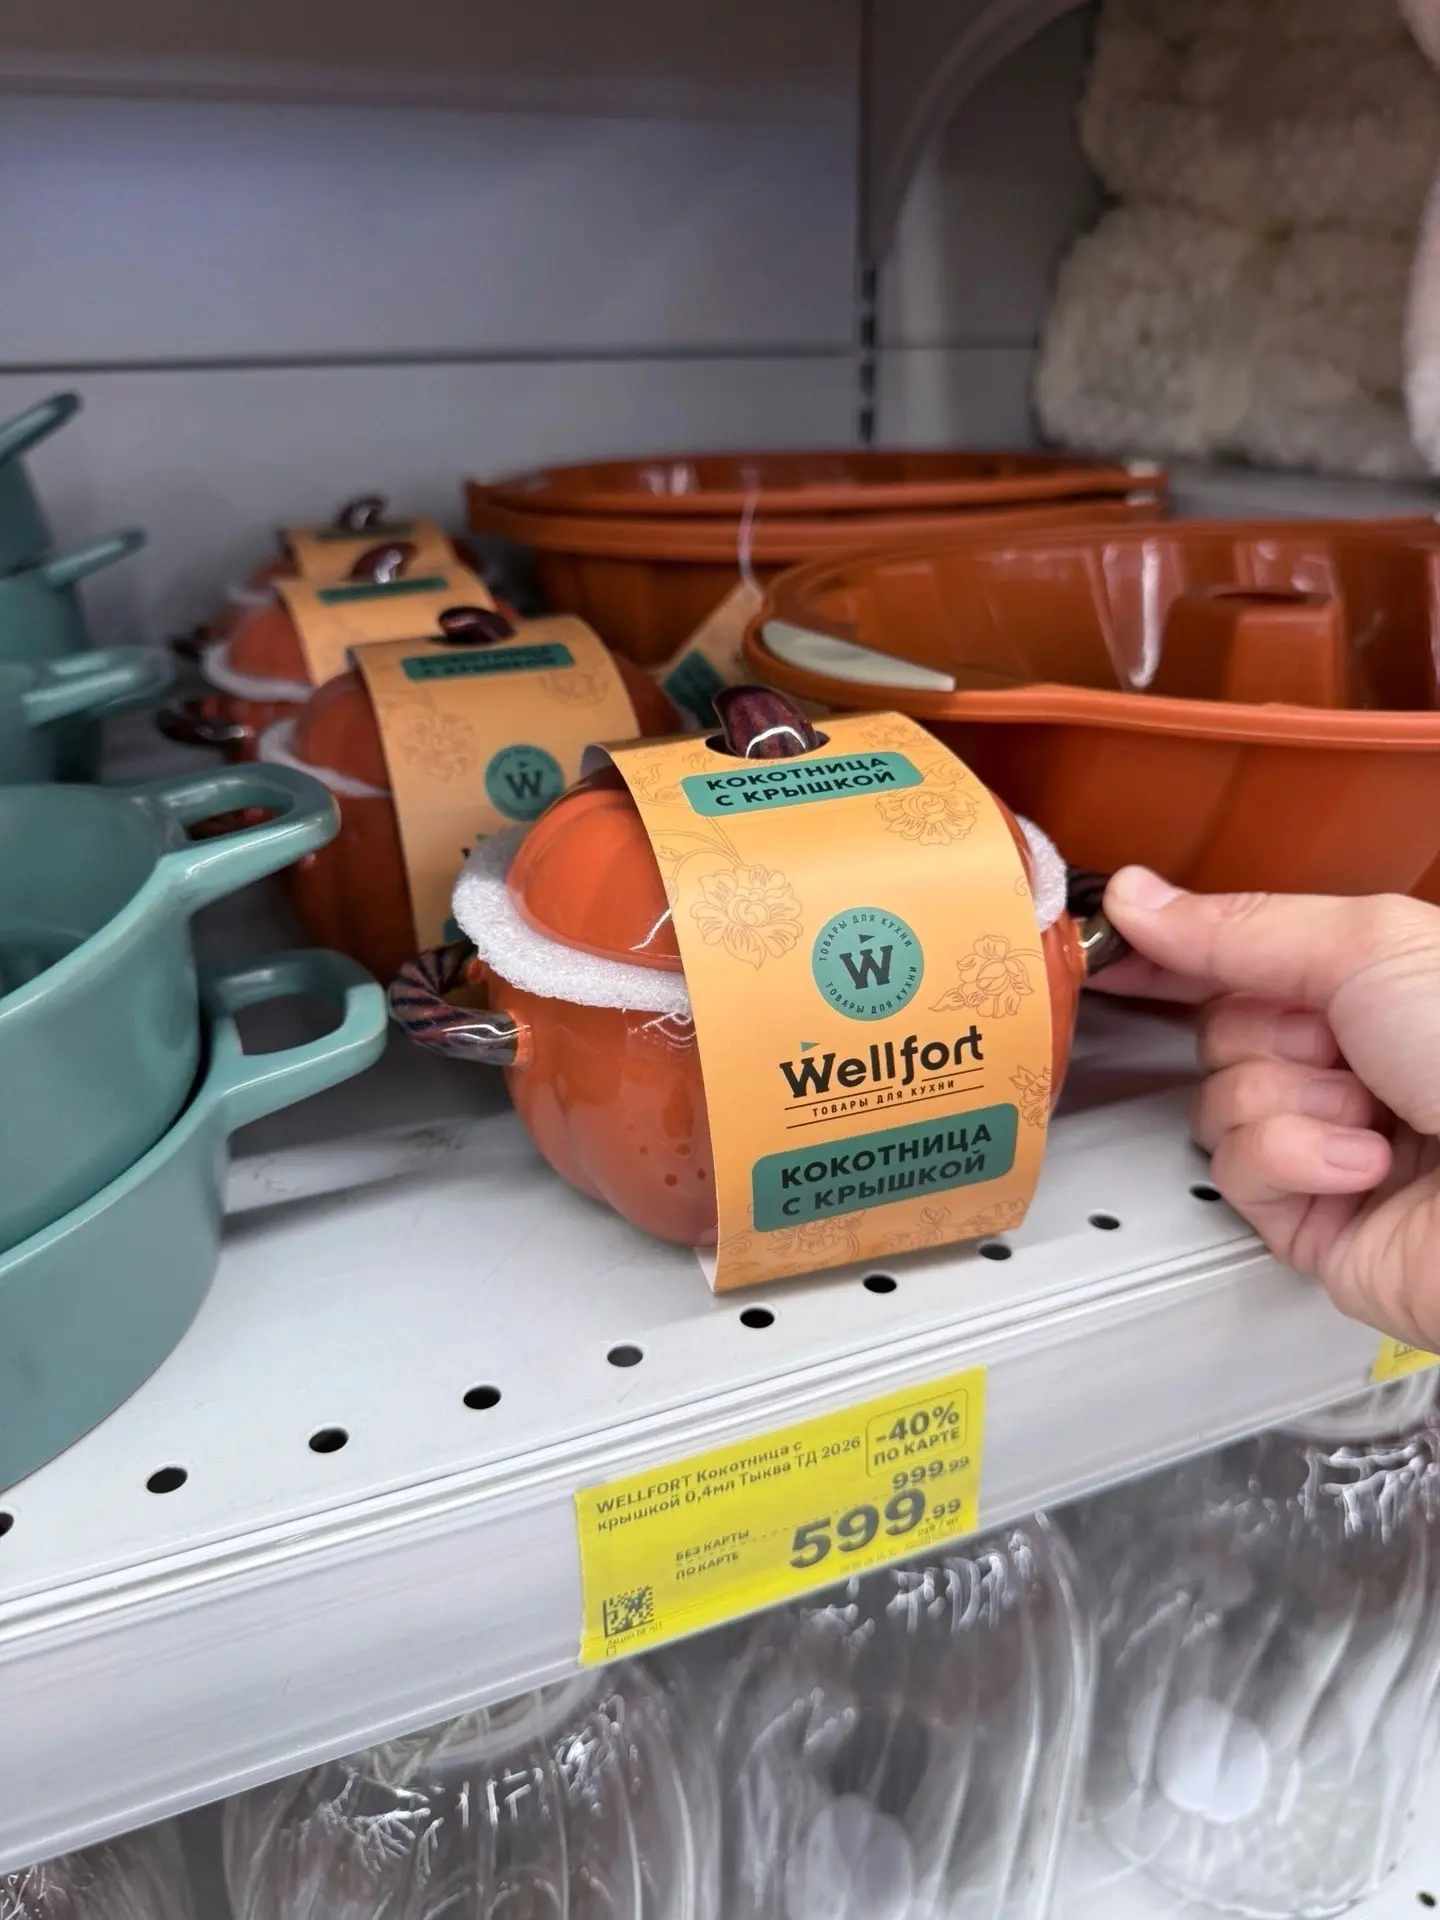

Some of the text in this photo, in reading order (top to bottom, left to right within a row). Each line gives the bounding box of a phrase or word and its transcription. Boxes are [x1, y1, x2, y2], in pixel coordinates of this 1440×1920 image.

[504, 769, 543, 799] W
[706, 758, 889, 791] КОКОТНИЦА
[716, 769, 897, 807] С КРЫШКОЙ
[819, 920, 847, 961] ТОВАРЫ
[881, 917, 912, 947] КУХНИ
[839, 944, 893, 990] W
[825, 981, 865, 1014] ТОВАРЫ
[896, 966, 917, 1002] КУХНИ
[779, 1025, 984, 1099] Wellfort
[812, 1079, 955, 1117] ТОВАРЫ ДЛЯ КУХНИ
[781, 1123, 992, 1189] КОКОТНИЦА
[781, 1150, 986, 1216] С КРЫШКОЙ
[876, 1401, 960, 1442] -40%
[873, 1426, 960, 1466] ПО КАРТЕ
[596, 1474, 692, 1514] WELLFORT
[696, 1445, 790, 1483] Кокотница
[597, 1436, 861, 1532] крышкой 0,4мл Тыква ТД 2026
[676, 1529, 750, 1562] БЕЗ КАРТЫ
[676, 1551, 739, 1580] ПО КАРТЕ
